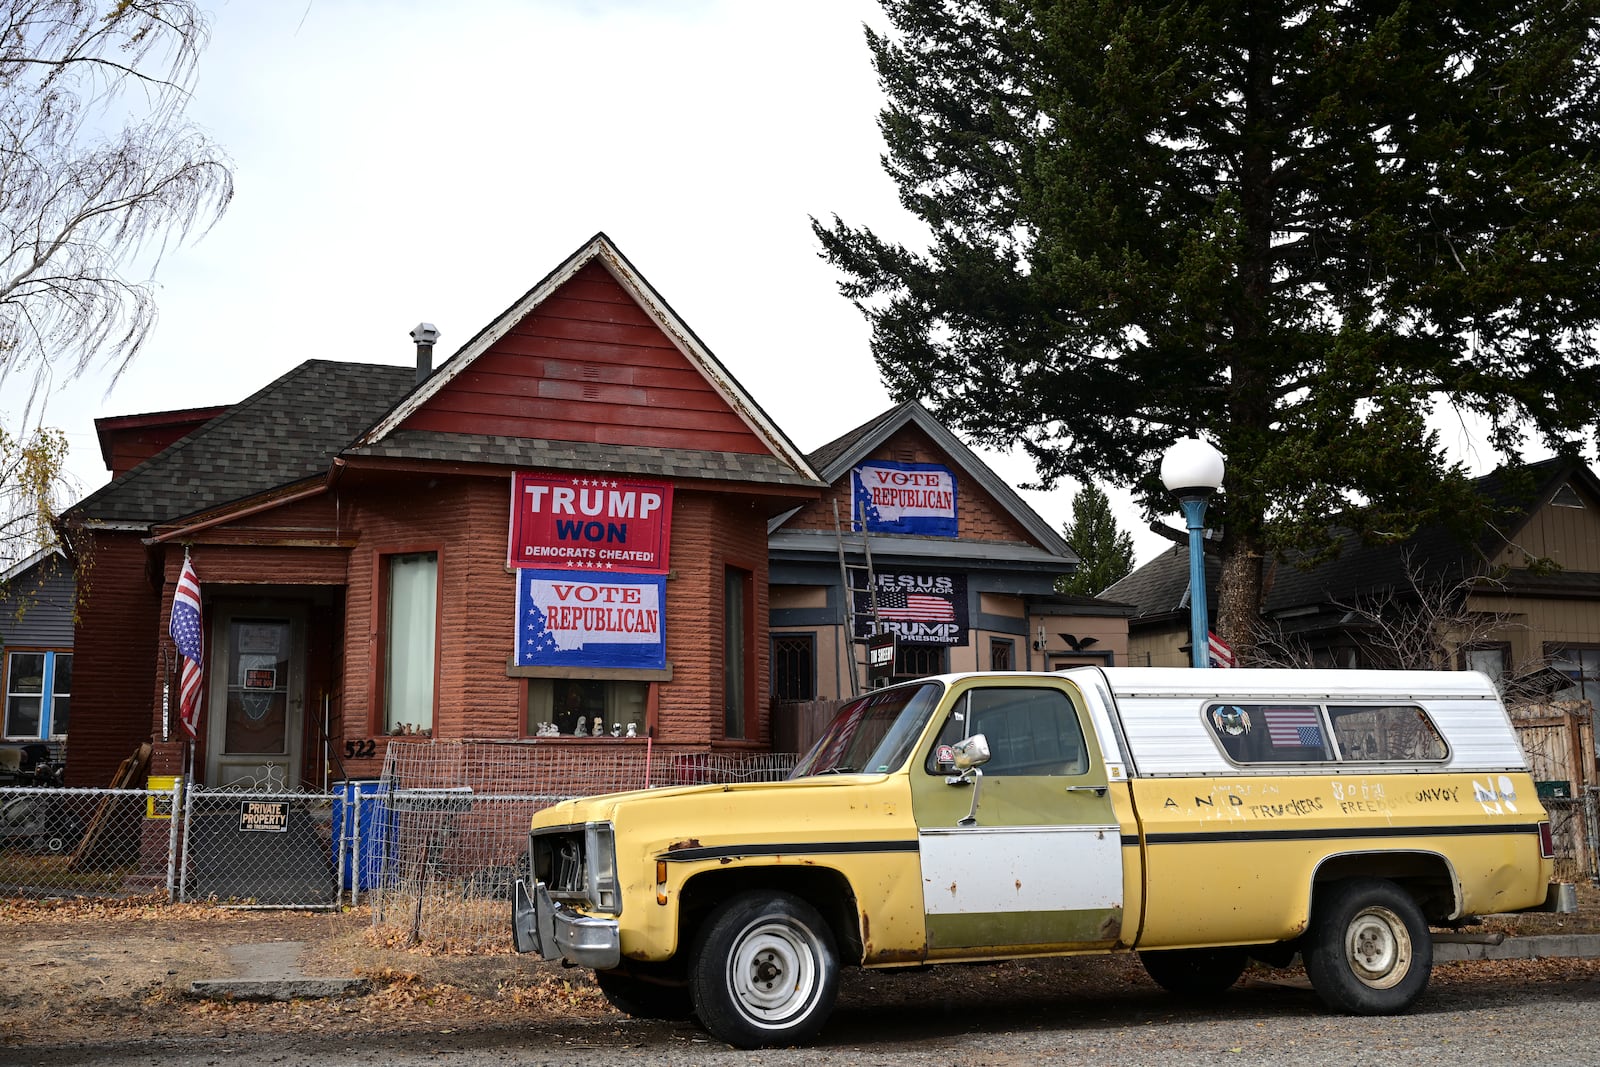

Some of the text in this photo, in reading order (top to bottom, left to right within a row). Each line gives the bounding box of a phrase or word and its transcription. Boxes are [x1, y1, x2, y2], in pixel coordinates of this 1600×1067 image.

[874, 471, 939, 487] VOTE
[525, 485, 661, 520] TRUMP
[872, 487, 952, 510] REPUBLICAN
[556, 519, 627, 544] WON
[525, 546, 654, 562] DEMOCRATS CHEATED!
[551, 585, 641, 604] VOTE
[906, 587, 954, 595] SAVIOR
[546, 605, 658, 634] REPUBLICAN
[866, 621, 960, 637] TRUMP
[900, 635, 960, 643] PRESIDENT
[344, 740, 376, 758] 522
[248, 803, 282, 815] PRIVATE
[1248, 796, 1324, 819] TRUCKERS
[242, 813, 286, 825] PROPERTY
